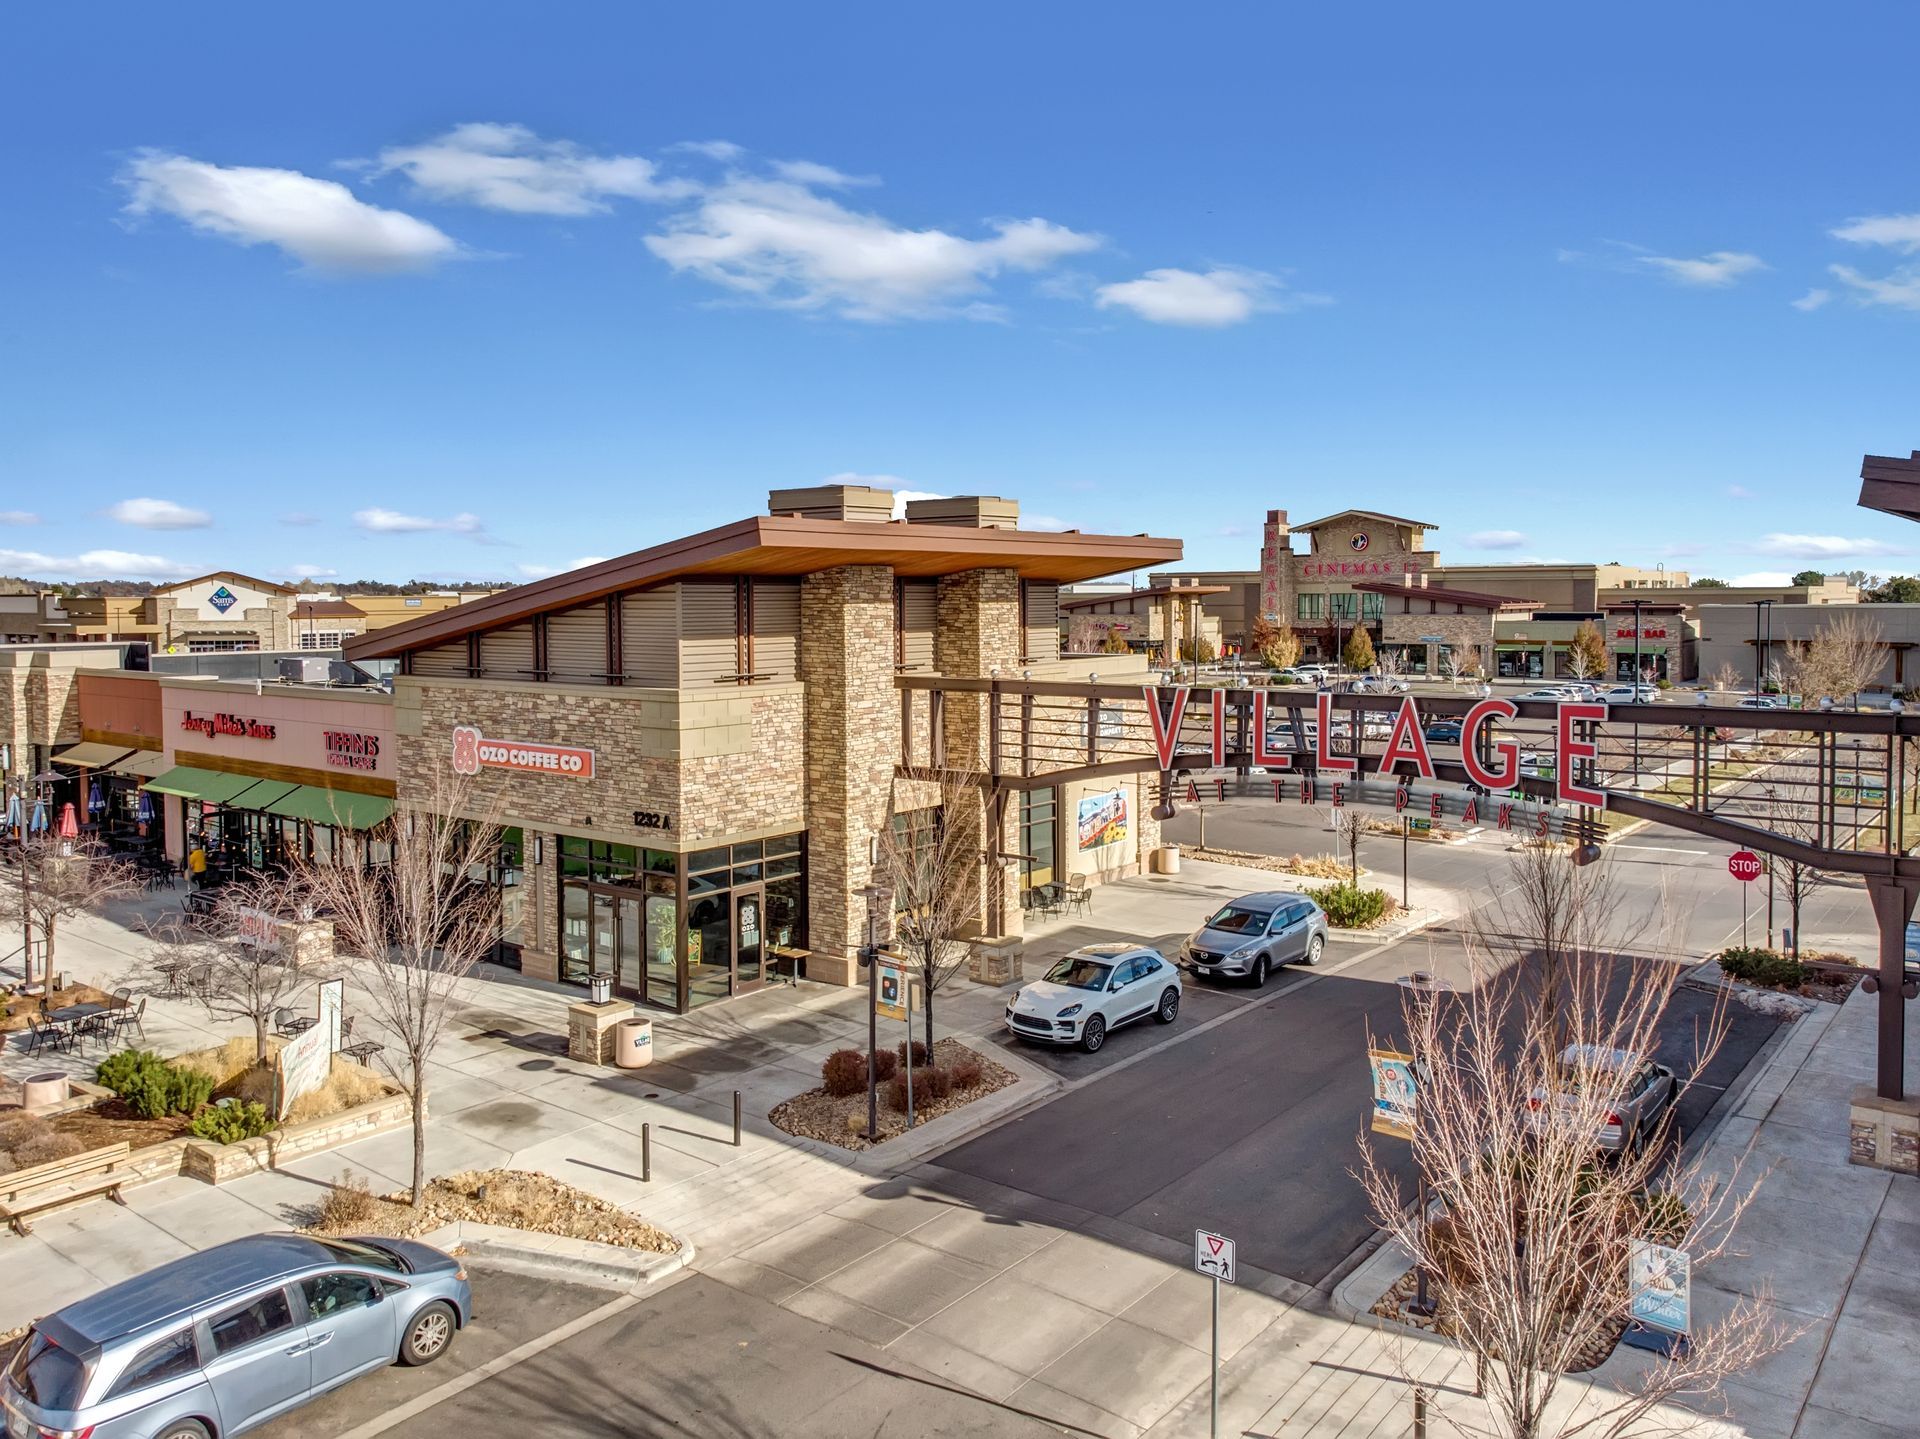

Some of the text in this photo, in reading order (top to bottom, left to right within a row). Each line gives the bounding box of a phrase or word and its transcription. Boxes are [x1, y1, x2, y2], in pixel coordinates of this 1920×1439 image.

[1266, 530, 1277, 609] REGAL
[1303, 561, 1418, 577] CINEMAS 12
[1617, 629, 1666, 638] NAI BAR
[245, 719, 276, 739] Subs
[1143, 686, 1608, 810] VILLAGE
[479, 746, 582, 771] OZO COFFEE CO
[1186, 778, 1227, 803] AT
[1270, 779, 1345, 808] THE
[1395, 788, 1550, 837] PEAKS
[633, 811, 672, 830] 1232 A
[1730, 860, 1760, 872] STOP
